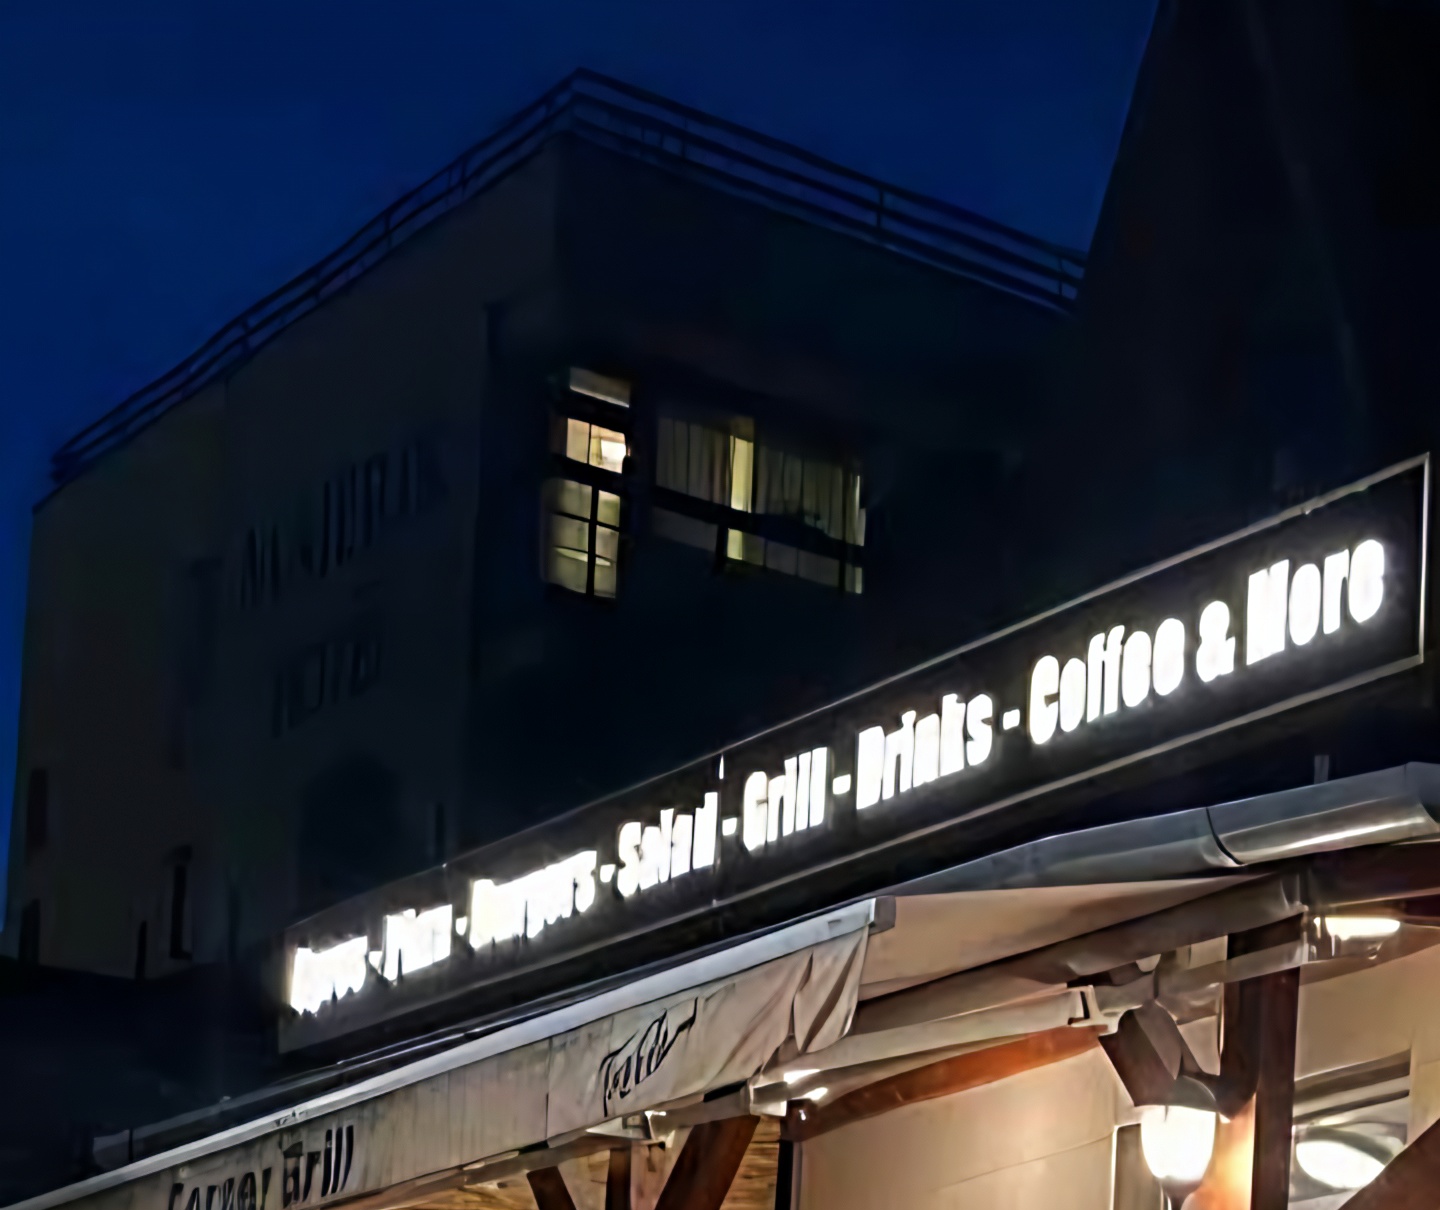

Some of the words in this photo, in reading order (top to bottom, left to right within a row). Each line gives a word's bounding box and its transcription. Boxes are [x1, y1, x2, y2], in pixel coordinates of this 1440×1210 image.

[743, 747, 827, 851] Grill
[856, 693, 993, 810] Drinks
[1029, 618, 1186, 745] Coffee
[1196, 601, 1236, 683] &
[1246, 539, 1386, 665] More
